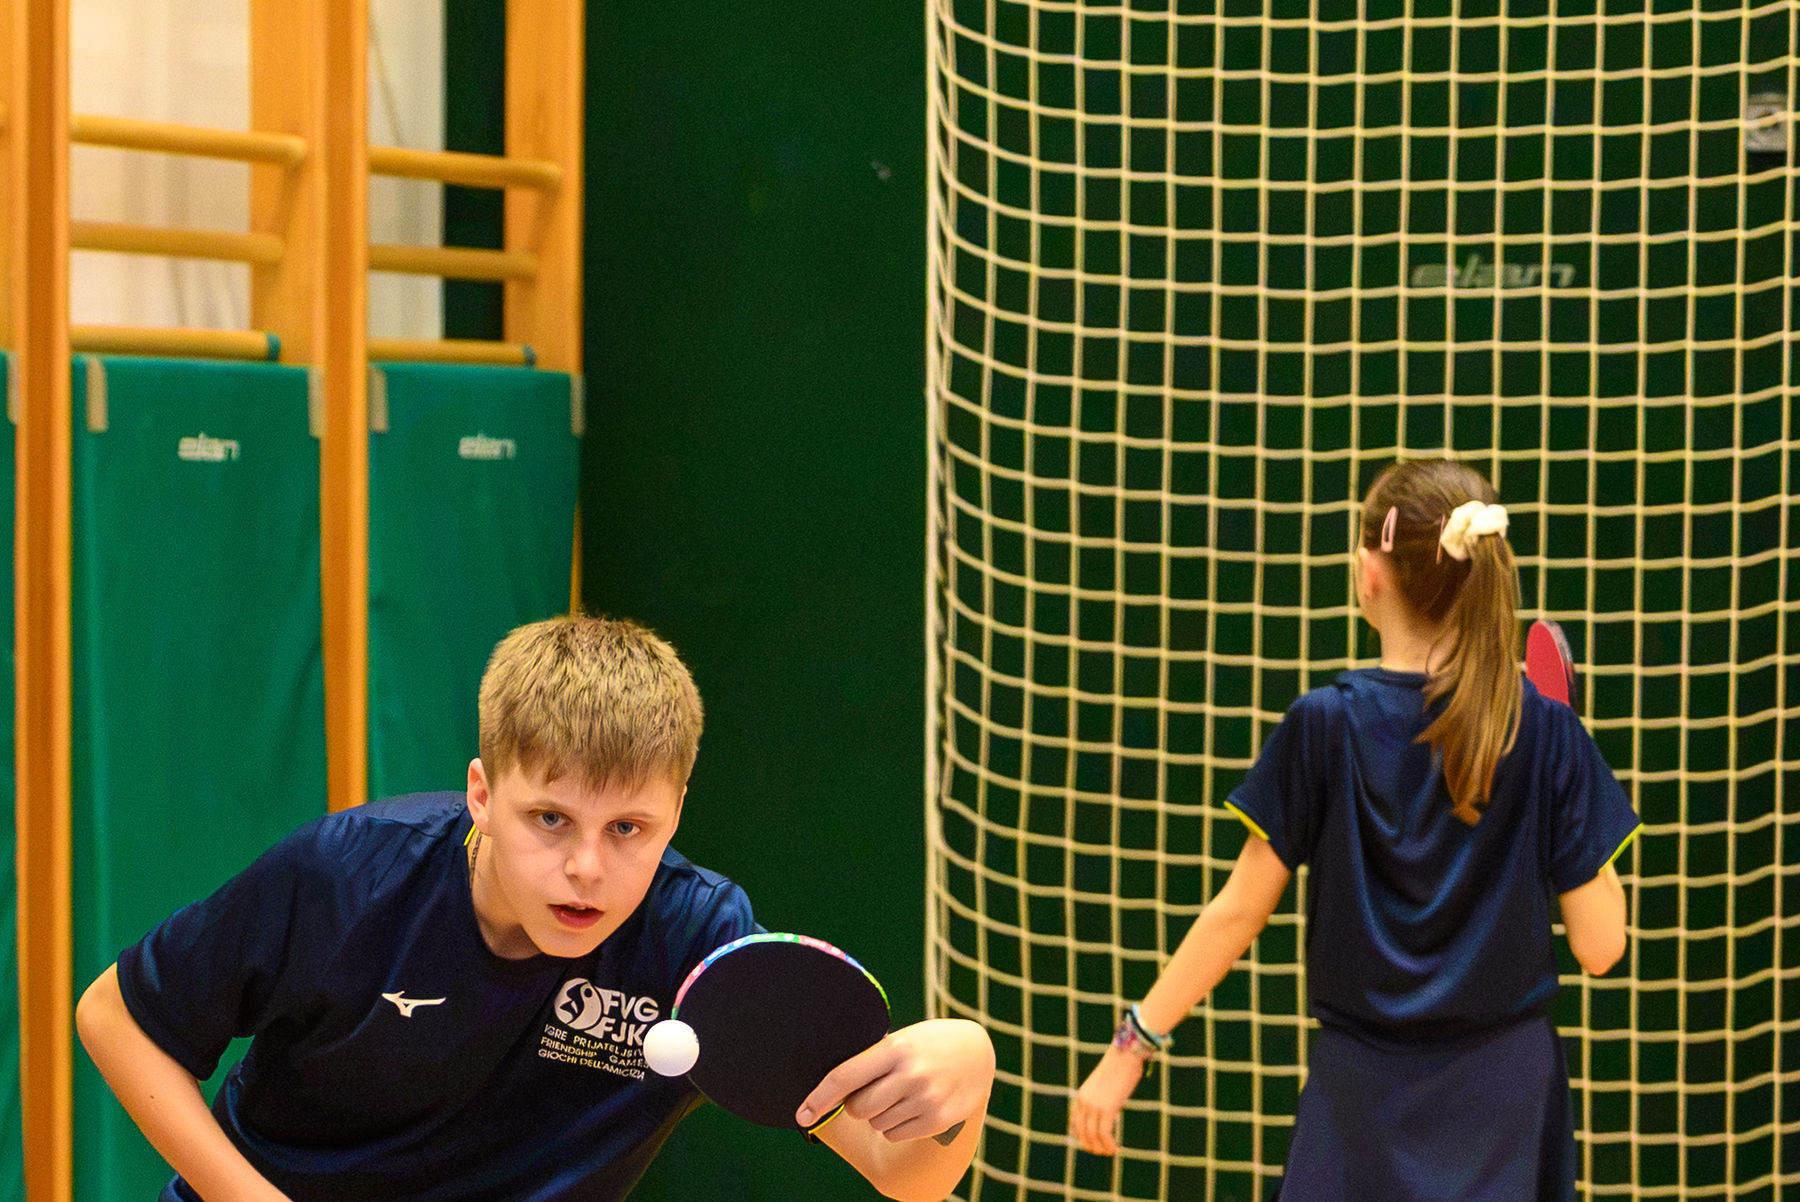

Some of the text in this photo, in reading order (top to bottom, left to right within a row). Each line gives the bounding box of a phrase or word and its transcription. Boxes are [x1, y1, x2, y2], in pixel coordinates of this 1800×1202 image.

[596, 986, 660, 1023] FVG
[540, 1036, 597, 1058] FRIENDSHIP
[544, 1024, 644, 1057] IGRE PRIJATELJSTV
[585, 1016, 648, 1047] FJK
[538, 1048, 578, 1064] GIOCHI
